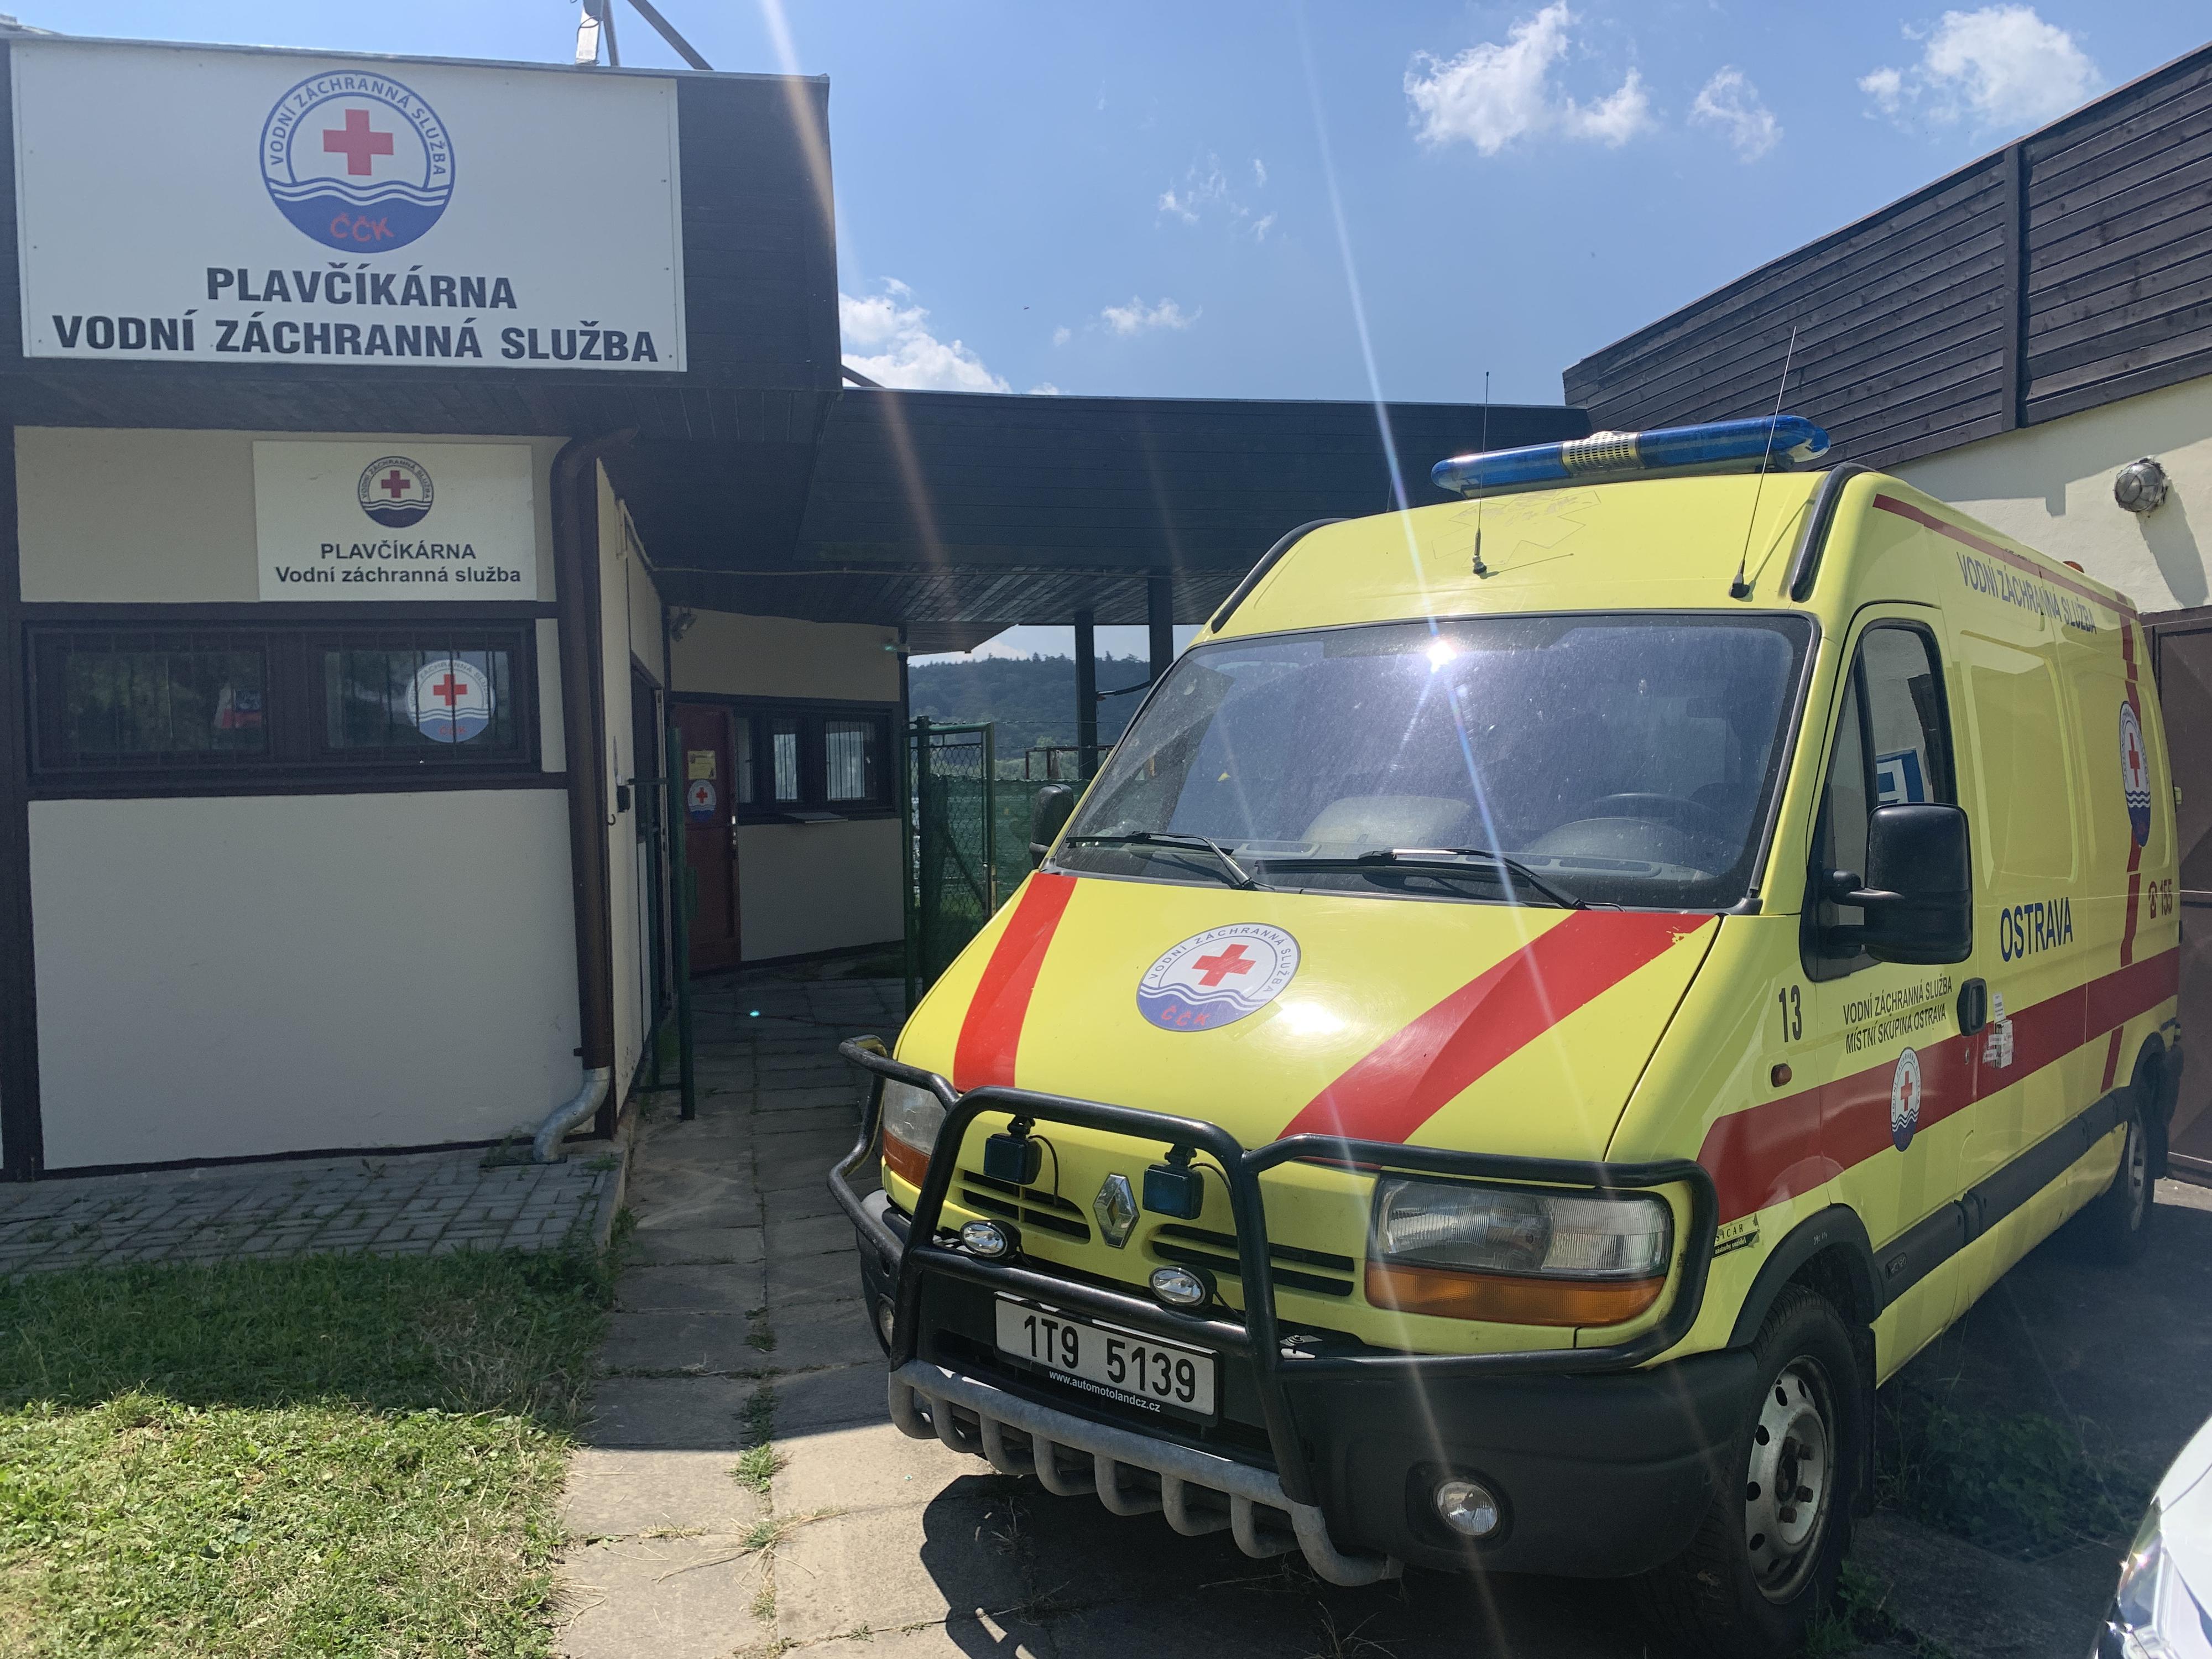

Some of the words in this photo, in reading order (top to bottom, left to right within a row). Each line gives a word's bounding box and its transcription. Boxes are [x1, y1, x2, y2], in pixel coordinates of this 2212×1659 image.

[270, 103, 296, 165] VODNÍ
[294, 76, 412, 108] ZÁCHRANNÁ
[411, 108, 446, 175] SLUŽBA
[330, 212, 394, 242] ČČK
[207, 262, 518, 309] PLAVČÍKÁRNA
[53, 309, 199, 351] VODNÍ
[215, 311, 483, 358] ZÁCHRANNÁ
[501, 320, 658, 362] SLUŽBA
[275, 566, 335, 582] Vodní
[342, 566, 447, 582] záchranná
[455, 566, 521, 582] služba
[321, 540, 476, 560] PLAVČÍKÁRNA
[1957, 552, 1999, 598] VODNÍ
[1996, 565, 2062, 622] ZÁCHRANNÁ
[2159, 879, 2172, 916] 155
[2000, 897, 2073, 962] OSTRAVA
[1149, 945, 1187, 980] VODNÍ
[1194, 927, 1287, 945] ZÁCHRANNÁ
[1263, 948, 1291, 993] SLUŽBA
[1161, 1005, 1211, 1026] ČČK
[1778, 985, 1802, 1042] 13
[1843, 993, 1872, 1025] VODNÍ
[1875, 979, 1923, 1016] ZÁCHRANNÁ
[1926, 973, 1952, 1000] SLUŽBA
[1846, 1020, 1878, 1054] MÍSTNÍ
[1878, 1014, 1913, 1043] SKUPINA
[1913, 1003, 1947, 1031] OSTRAVA
[1024, 1315, 1079, 1369] 1T9
[1107, 1338, 1196, 1402] 5139
[1049, 1370, 1161, 1413] www.automotolandcz.cz
